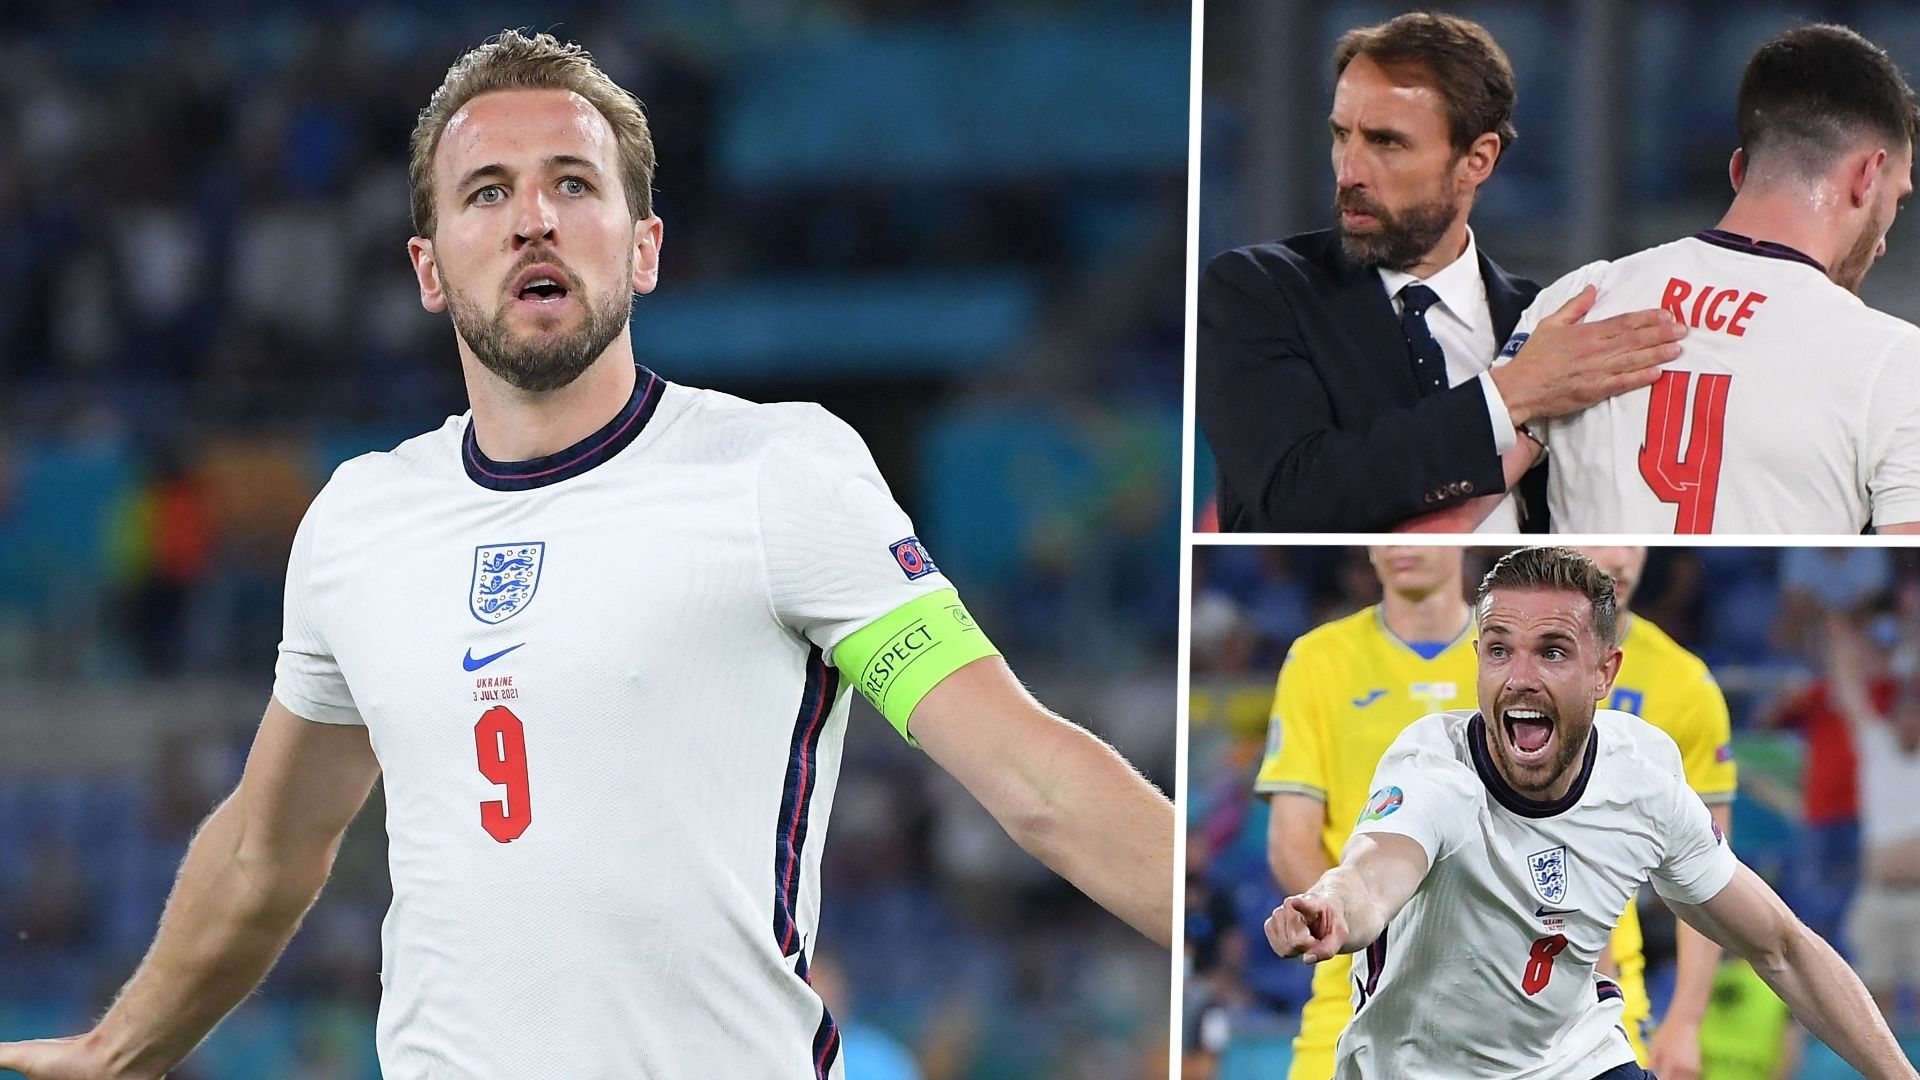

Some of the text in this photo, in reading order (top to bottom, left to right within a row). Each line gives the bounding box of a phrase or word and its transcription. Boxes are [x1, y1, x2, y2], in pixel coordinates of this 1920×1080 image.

[1661, 277, 1768, 337] RICE
[1638, 370, 1733, 534] 4
[476, 676, 513, 689] UKRAINE
[866, 624, 932, 697] RESPECT
[472, 687, 519, 702] 3 JULY 2021
[474, 705, 532, 843] 9
[1522, 933, 1569, 996] 8
